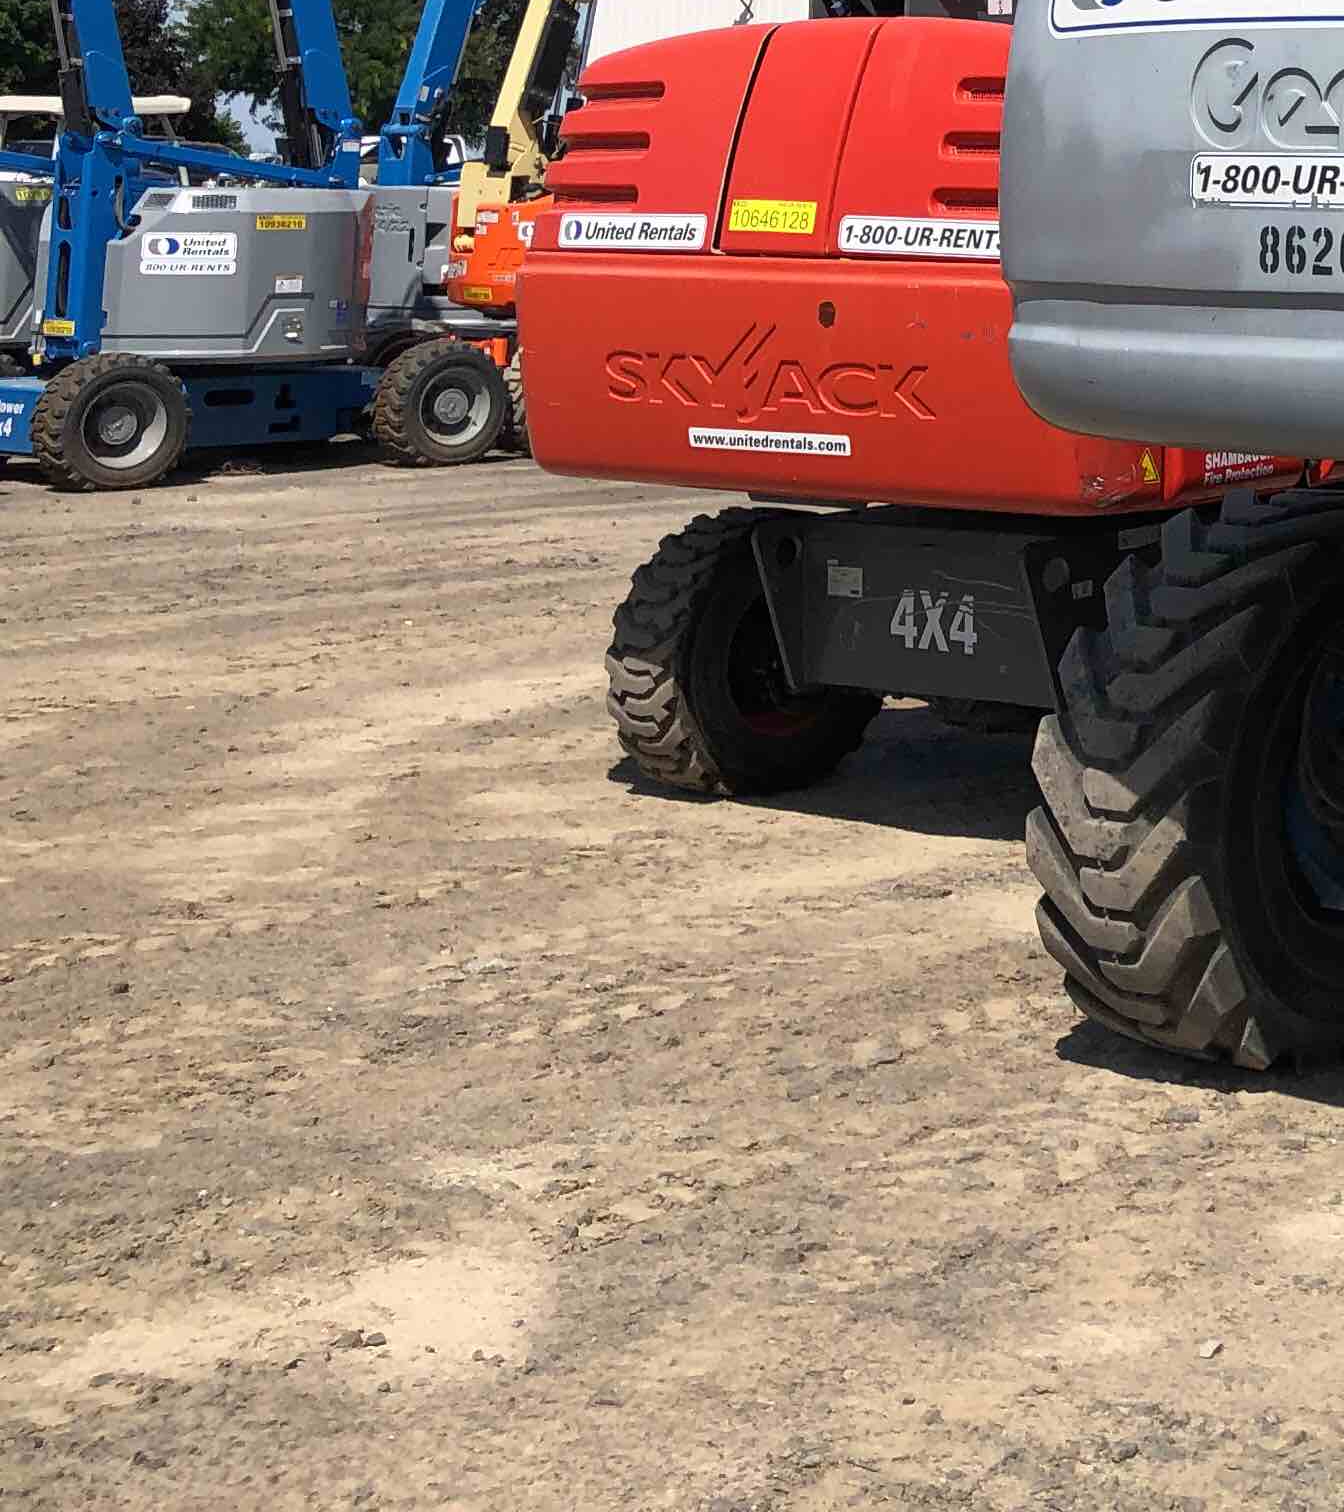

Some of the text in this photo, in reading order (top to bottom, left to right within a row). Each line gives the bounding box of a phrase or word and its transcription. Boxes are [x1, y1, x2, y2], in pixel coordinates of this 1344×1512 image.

[733, 210, 810, 231] 10646128
[585, 221, 697, 242] United Rentals
[845, 224, 1000, 250] 1-800-UR-RENT
[182, 237, 227, 248] United
[182, 247, 230, 256] Rentals
[605, 322, 937, 421] SKYJACK
[0, 402, 25, 415] ower
[693, 433, 847, 452] www.unitedrentals.com
[890, 589, 978, 656] 4X4
